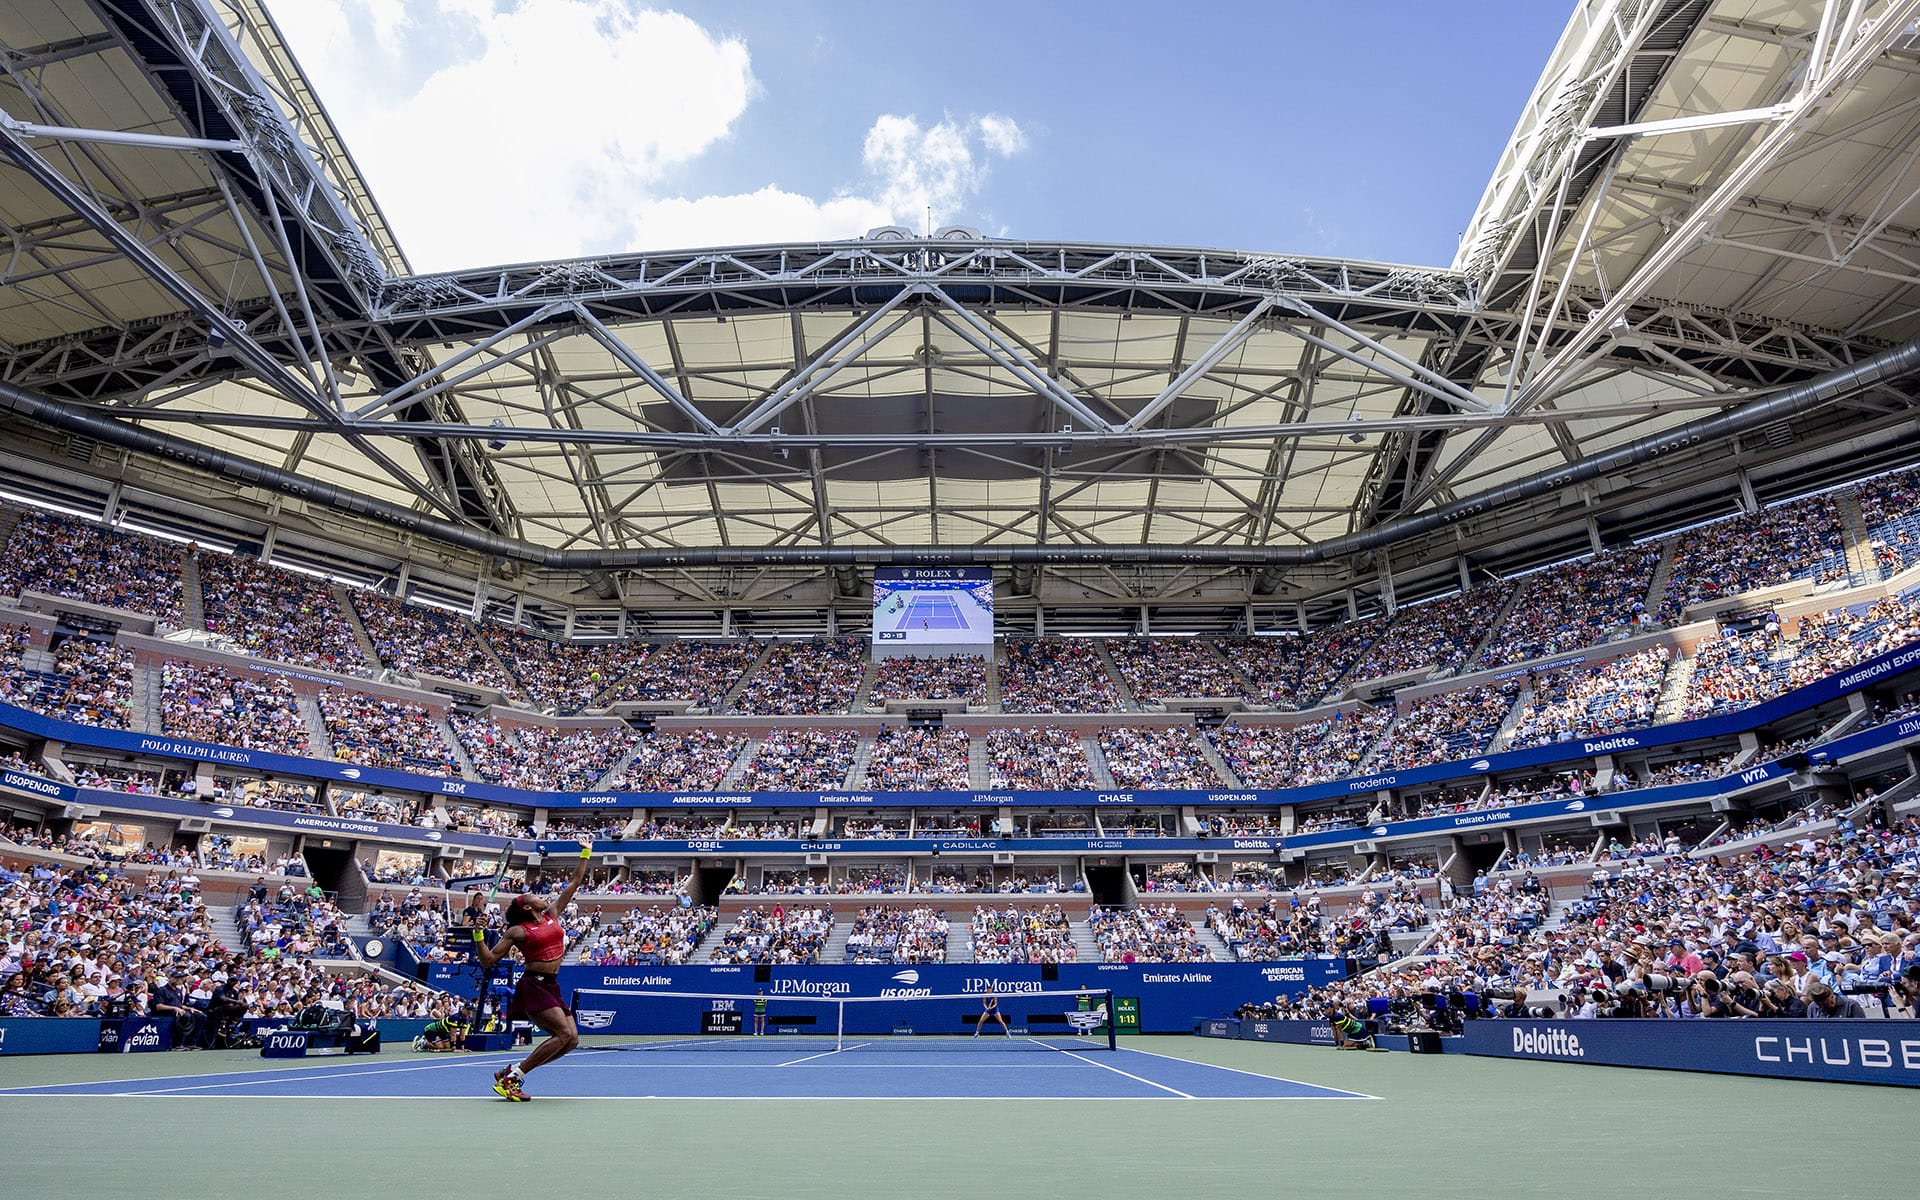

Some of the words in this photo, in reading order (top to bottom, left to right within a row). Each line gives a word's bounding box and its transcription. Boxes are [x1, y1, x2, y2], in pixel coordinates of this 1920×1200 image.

[1840, 661, 1892, 688] AMERICAN
[1898, 720, 1920, 735] J.P.M
[141, 739, 171, 752] POLO
[173, 744, 208, 757] RALPH
[210, 749, 251, 763] LAUREN
[1584, 737, 1639, 753] Deloitte.
[1741, 768, 1768, 784] WTA
[5, 774, 60, 796] USOPEN.ORG
[442, 782, 466, 794] IBM
[1350, 776, 1396, 790] moderna
[972, 794, 1013, 804] J.P.Morgan
[1455, 816, 1485, 825] Emirates
[1486, 812, 1510, 821] Airline
[294, 818, 340, 828] AMERICAN
[341, 822, 379, 833] EXPRESS
[1234, 840, 1270, 849] Deloitte.
[604, 976, 640, 985] Emirates
[642, 976, 672, 985] Airline
[1143, 973, 1180, 983] Emirates
[1182, 973, 1212, 983] Airline
[770, 979, 850, 997] J.P.Morgan
[962, 978, 1042, 996] J.P.Morgan
[712, 1000, 735, 1011] IBM
[712, 1014, 725, 1024] 111
[1120, 1015, 1135, 1024] 1:13
[101, 1034, 118, 1042] vian
[132, 1033, 160, 1046] evian
[270, 1036, 305, 1048] POLO
[1513, 1027, 1584, 1056] Deloitte.
